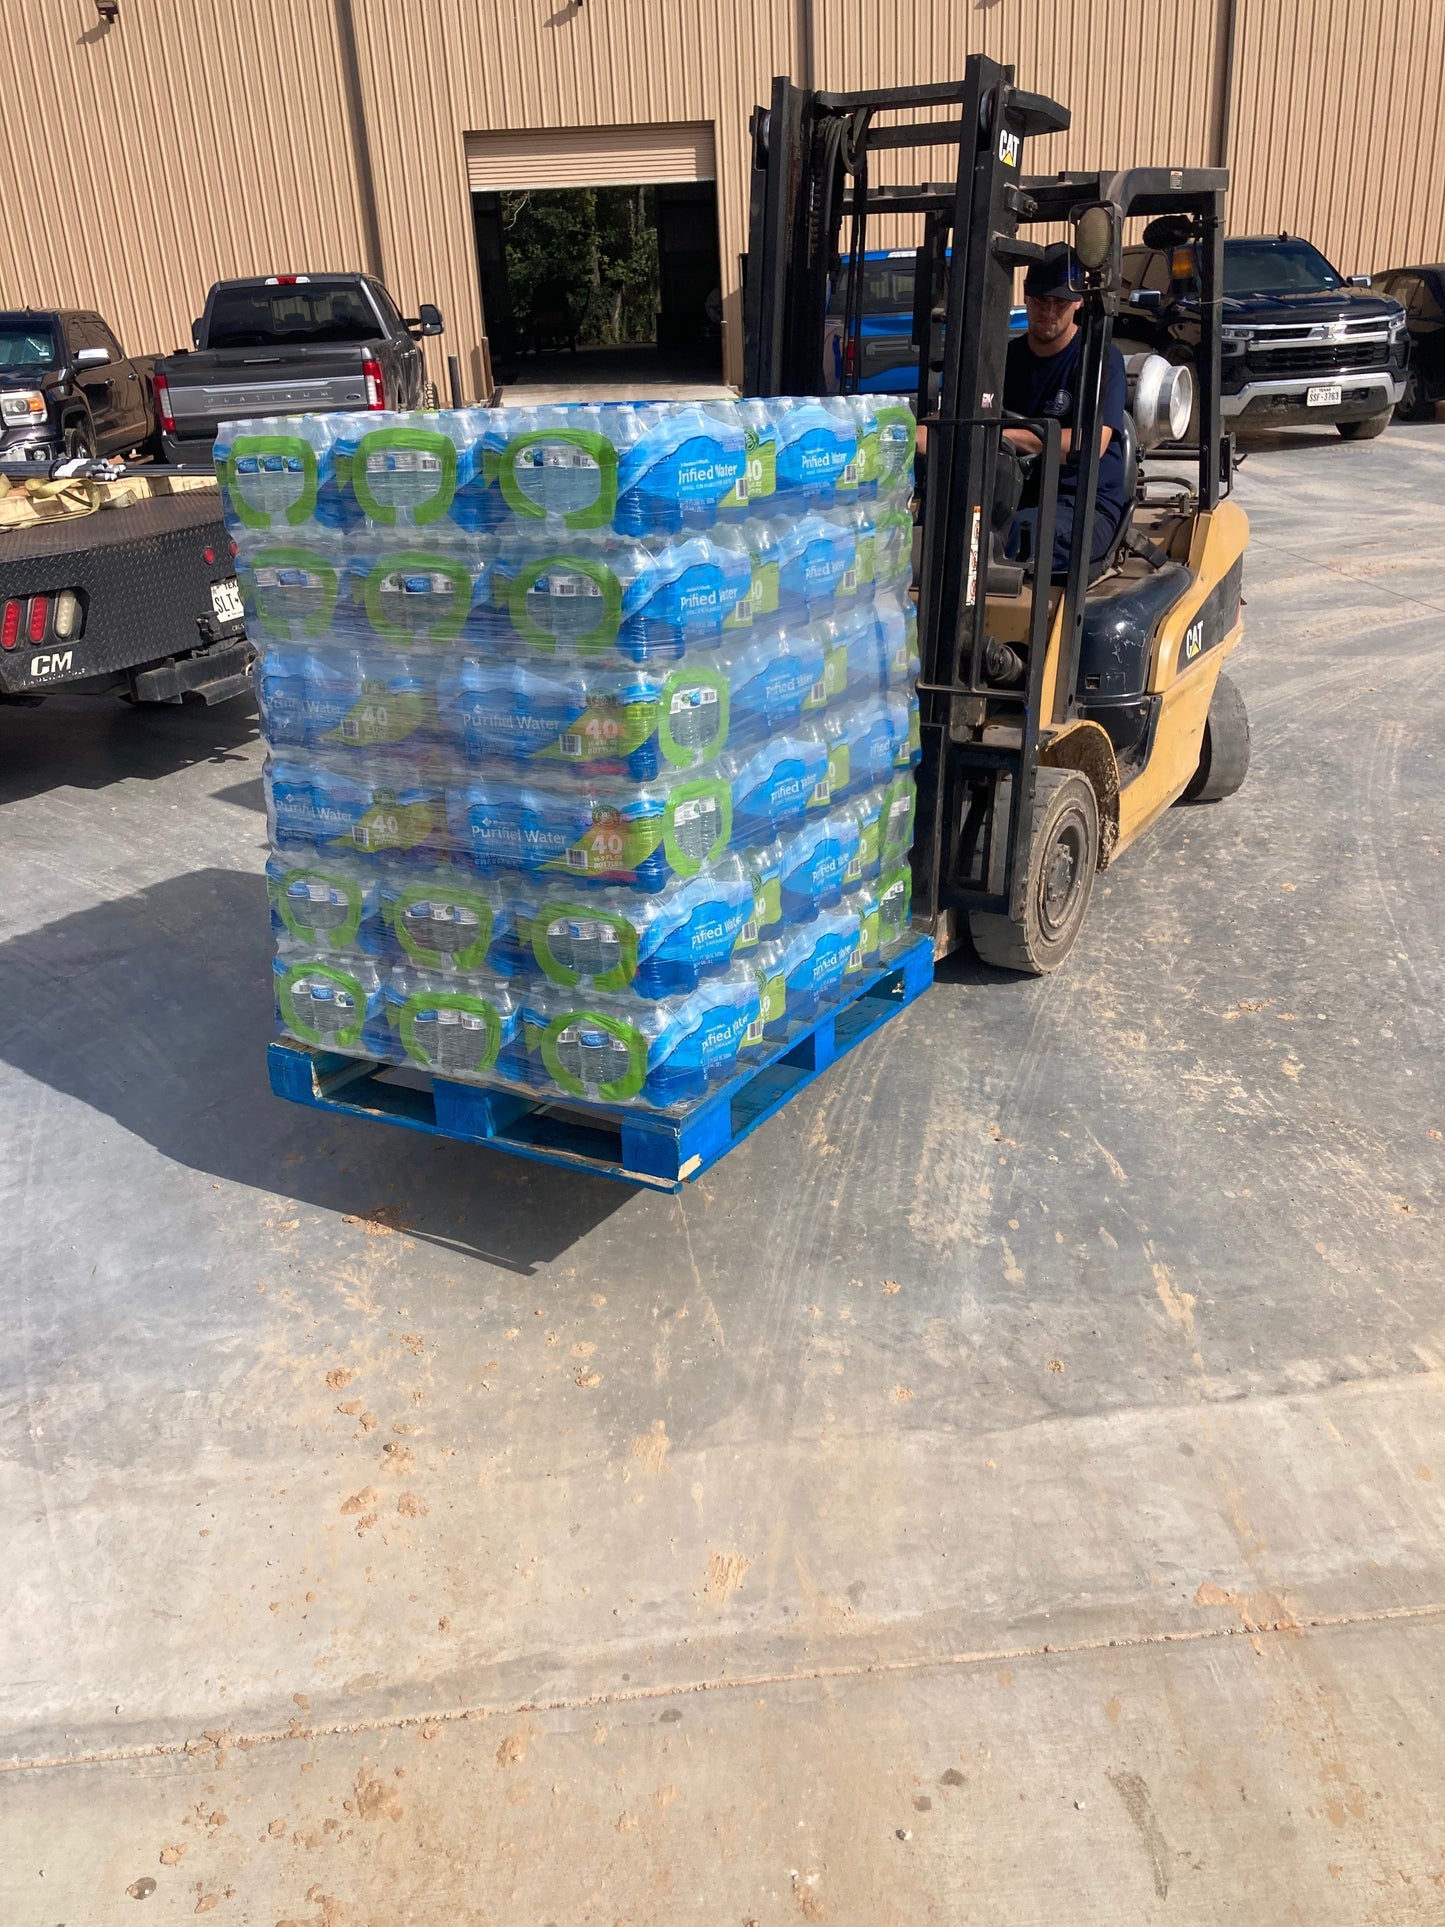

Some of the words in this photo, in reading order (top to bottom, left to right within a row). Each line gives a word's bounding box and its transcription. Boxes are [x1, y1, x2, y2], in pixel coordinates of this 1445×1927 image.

[998, 129, 1020, 168] CAT
[207, 389, 330, 404] PLATINUM
[1186, 620, 1204, 660] CAT
[30, 650, 73, 677] CM
[361, 705, 388, 726] 40
[516, 715, 560, 731] Water
[585, 718, 619, 741] 40
[315, 806, 354, 822] Water
[372, 814, 398, 834] 40
[524, 829, 567, 846] Water
[591, 833, 623, 855] 40
